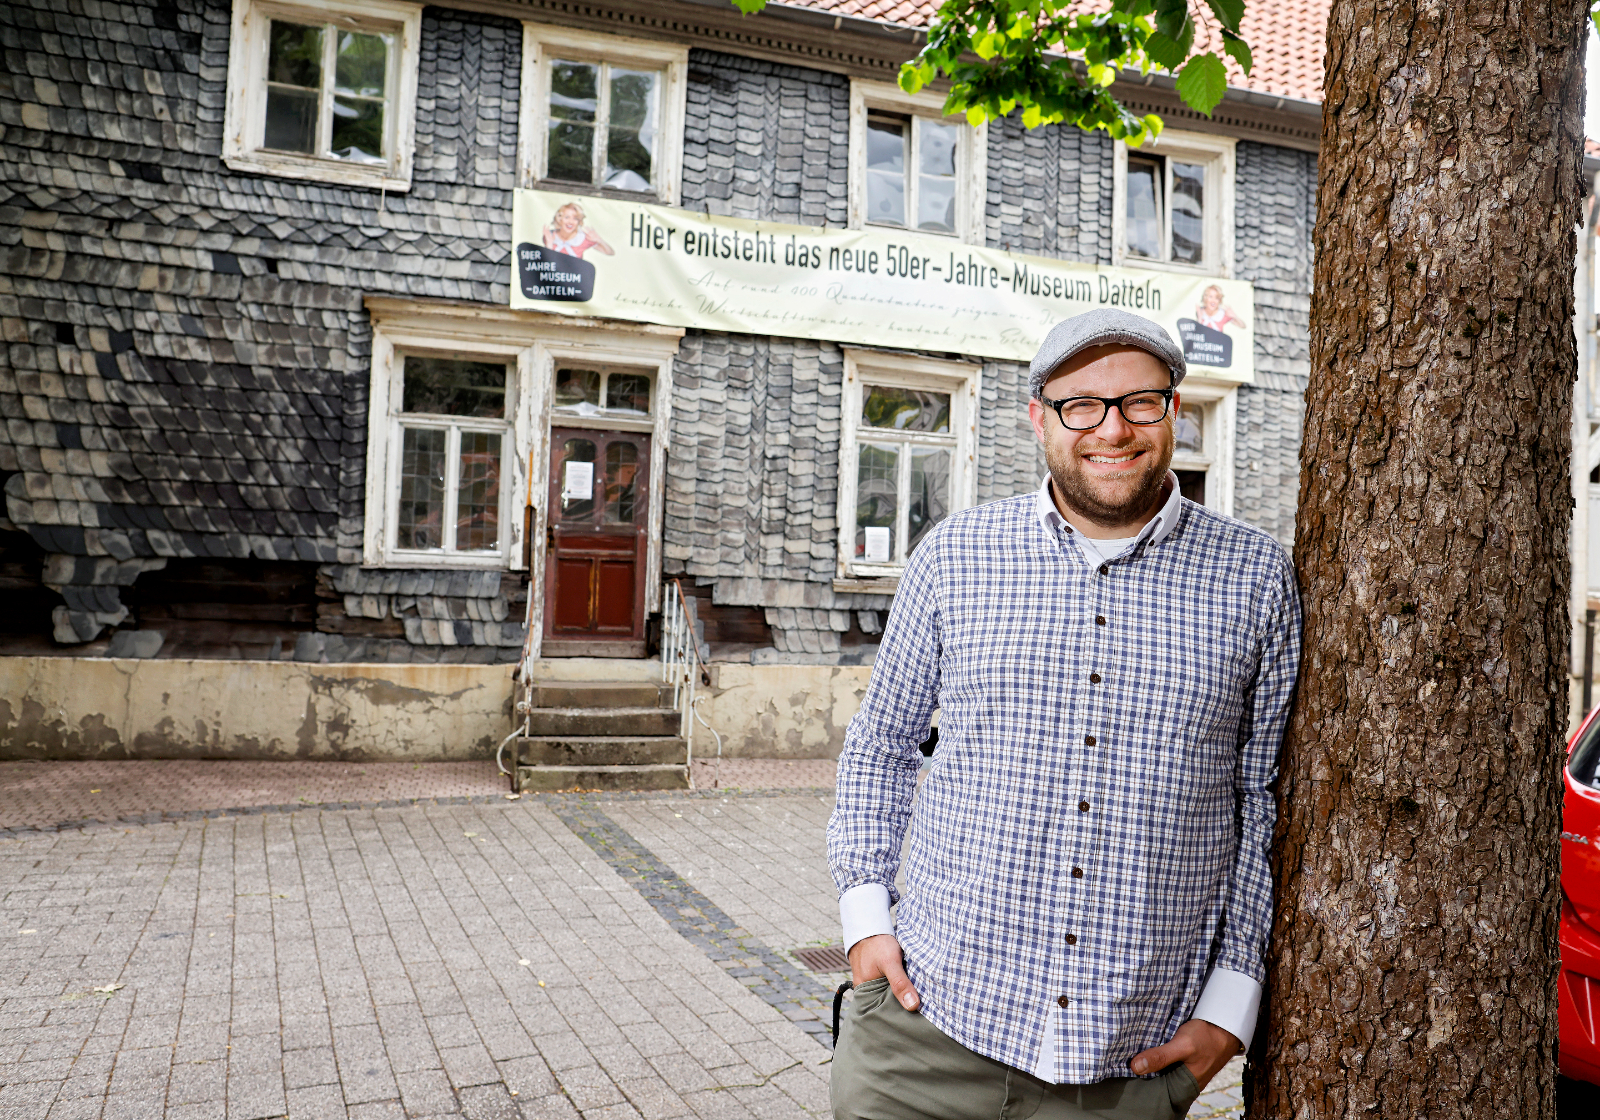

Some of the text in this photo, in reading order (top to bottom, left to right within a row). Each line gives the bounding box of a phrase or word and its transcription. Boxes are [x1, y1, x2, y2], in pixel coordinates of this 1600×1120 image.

[525, 261, 557, 272] JAHRE
[630, 212, 1161, 311] Hier entsteht das neue 50er-Jahre-Museum Datteln
[540, 272, 582, 283] MUSEUM
[687, 270, 733, 291] Auf
[741, 284, 781, 294] rund
[614, 292, 686, 309] deutsche
[695, 293, 866, 328] Wirtschaftswunder
[1193, 342, 1225, 353] MUSEUM
[1561, 831, 1589, 845] RSA
